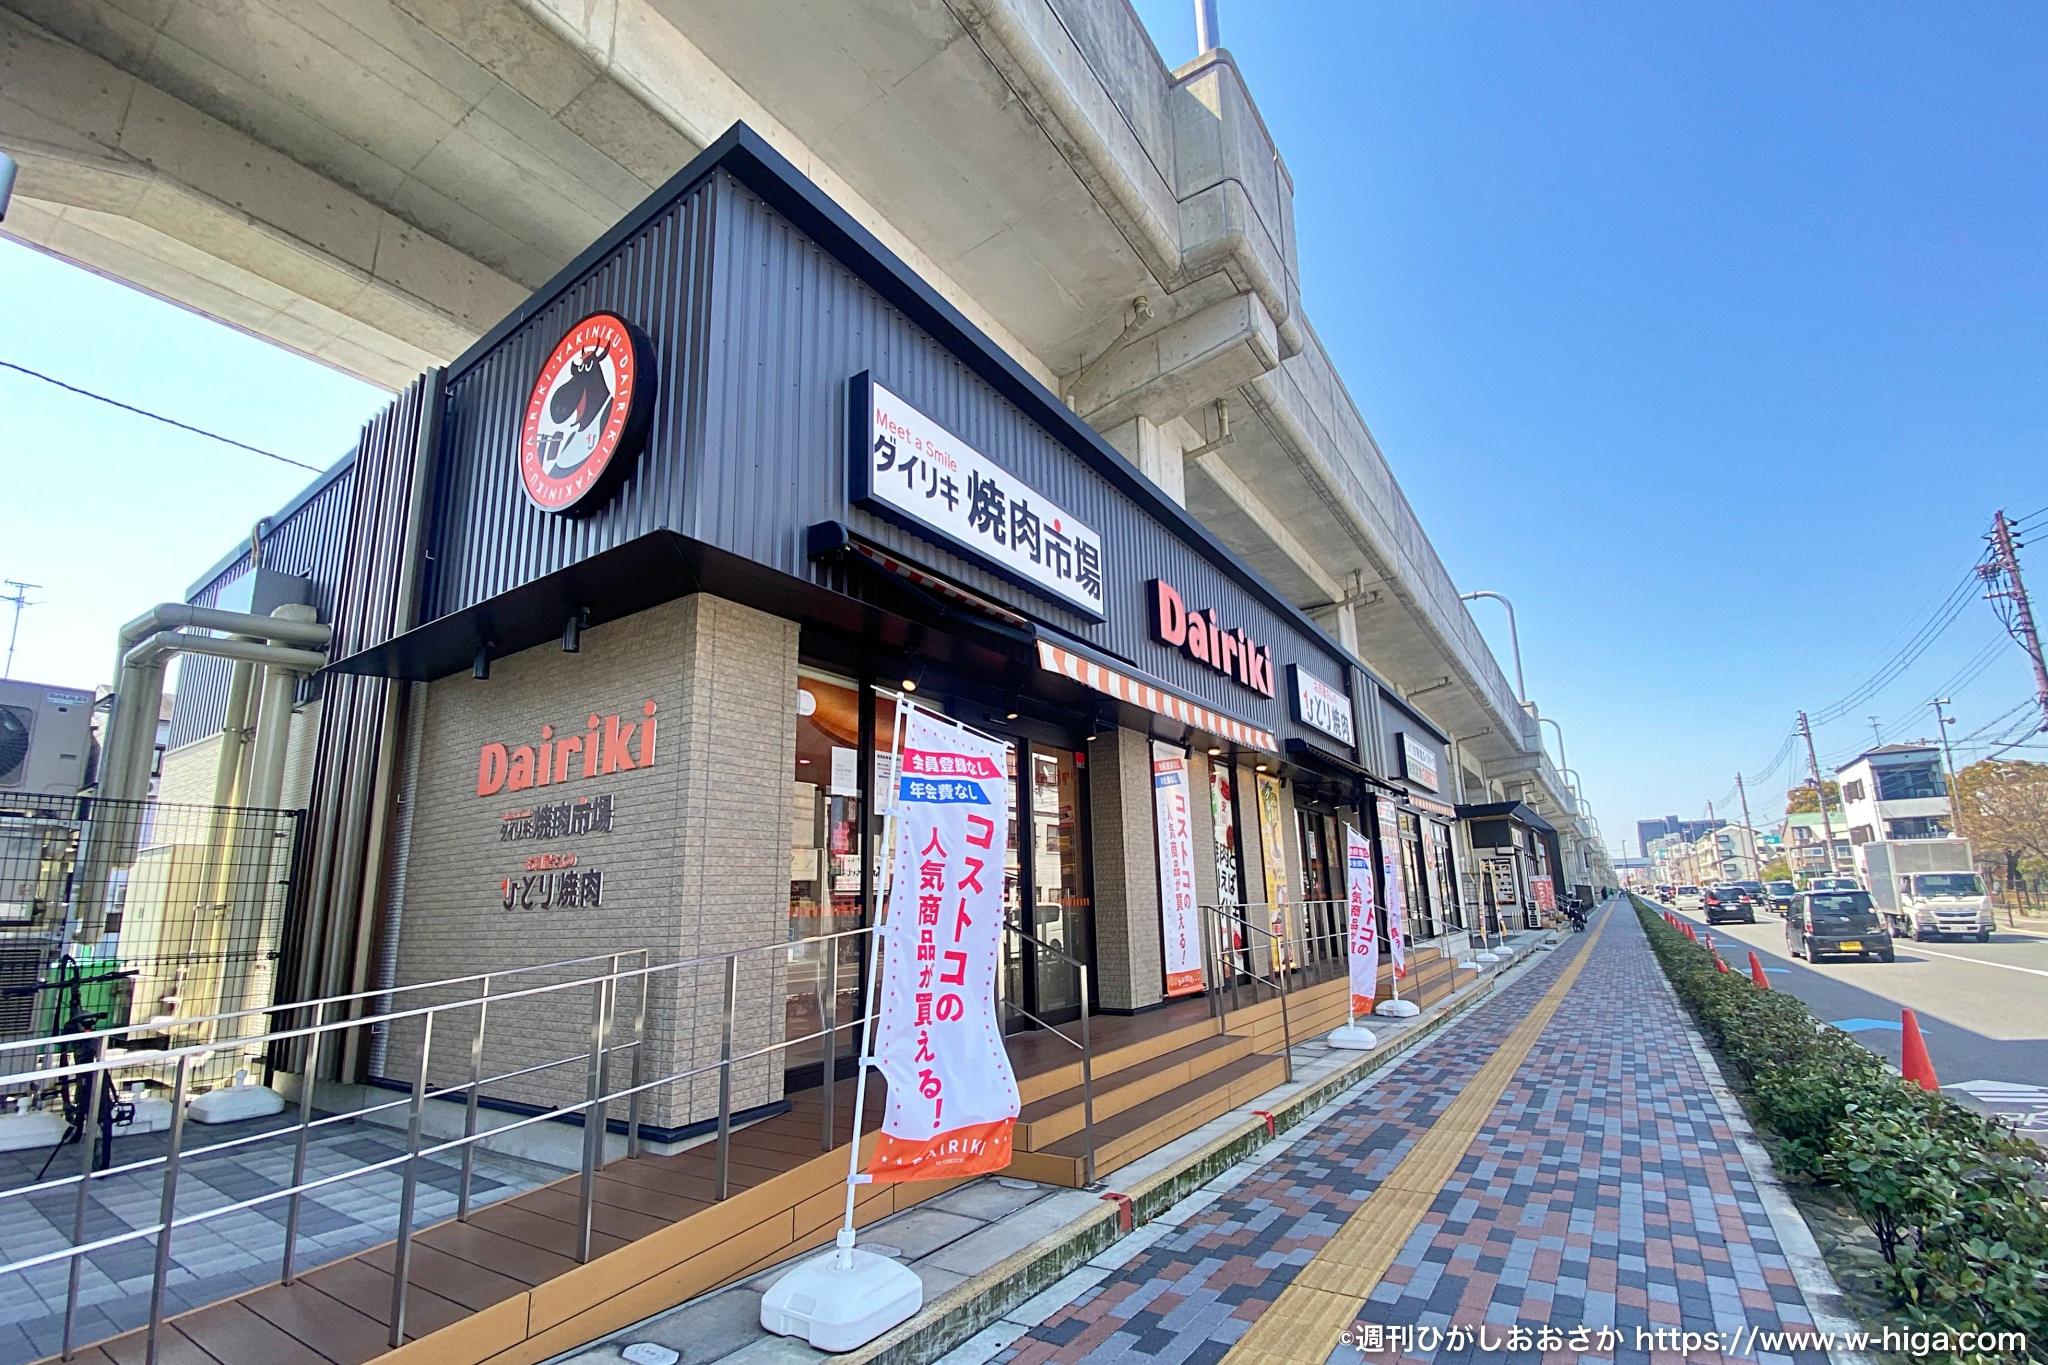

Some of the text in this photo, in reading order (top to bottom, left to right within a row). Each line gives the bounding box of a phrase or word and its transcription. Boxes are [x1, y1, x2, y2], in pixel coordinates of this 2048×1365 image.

[555, 324, 622, 363] YAKINIKU
[525, 373, 552, 464] DAIRIKI
[603, 354, 631, 455] DAIRIKI
[876, 408, 957, 473] Meet a Smile
[529, 467, 594, 501] YAKINIKU
[874, 434, 1101, 601] ダイリキ 焼肉市場
[1156, 578, 1275, 700] Dairiki
[477, 700, 657, 797] Dairiki
[909, 781, 978, 800] 年会費なし
[911, 753, 990, 777] 会員登録なし
[533, 794, 615, 840] 焼肉市場
[1175, 794, 1192, 910] コストコの
[934, 813, 996, 1023] コストコの
